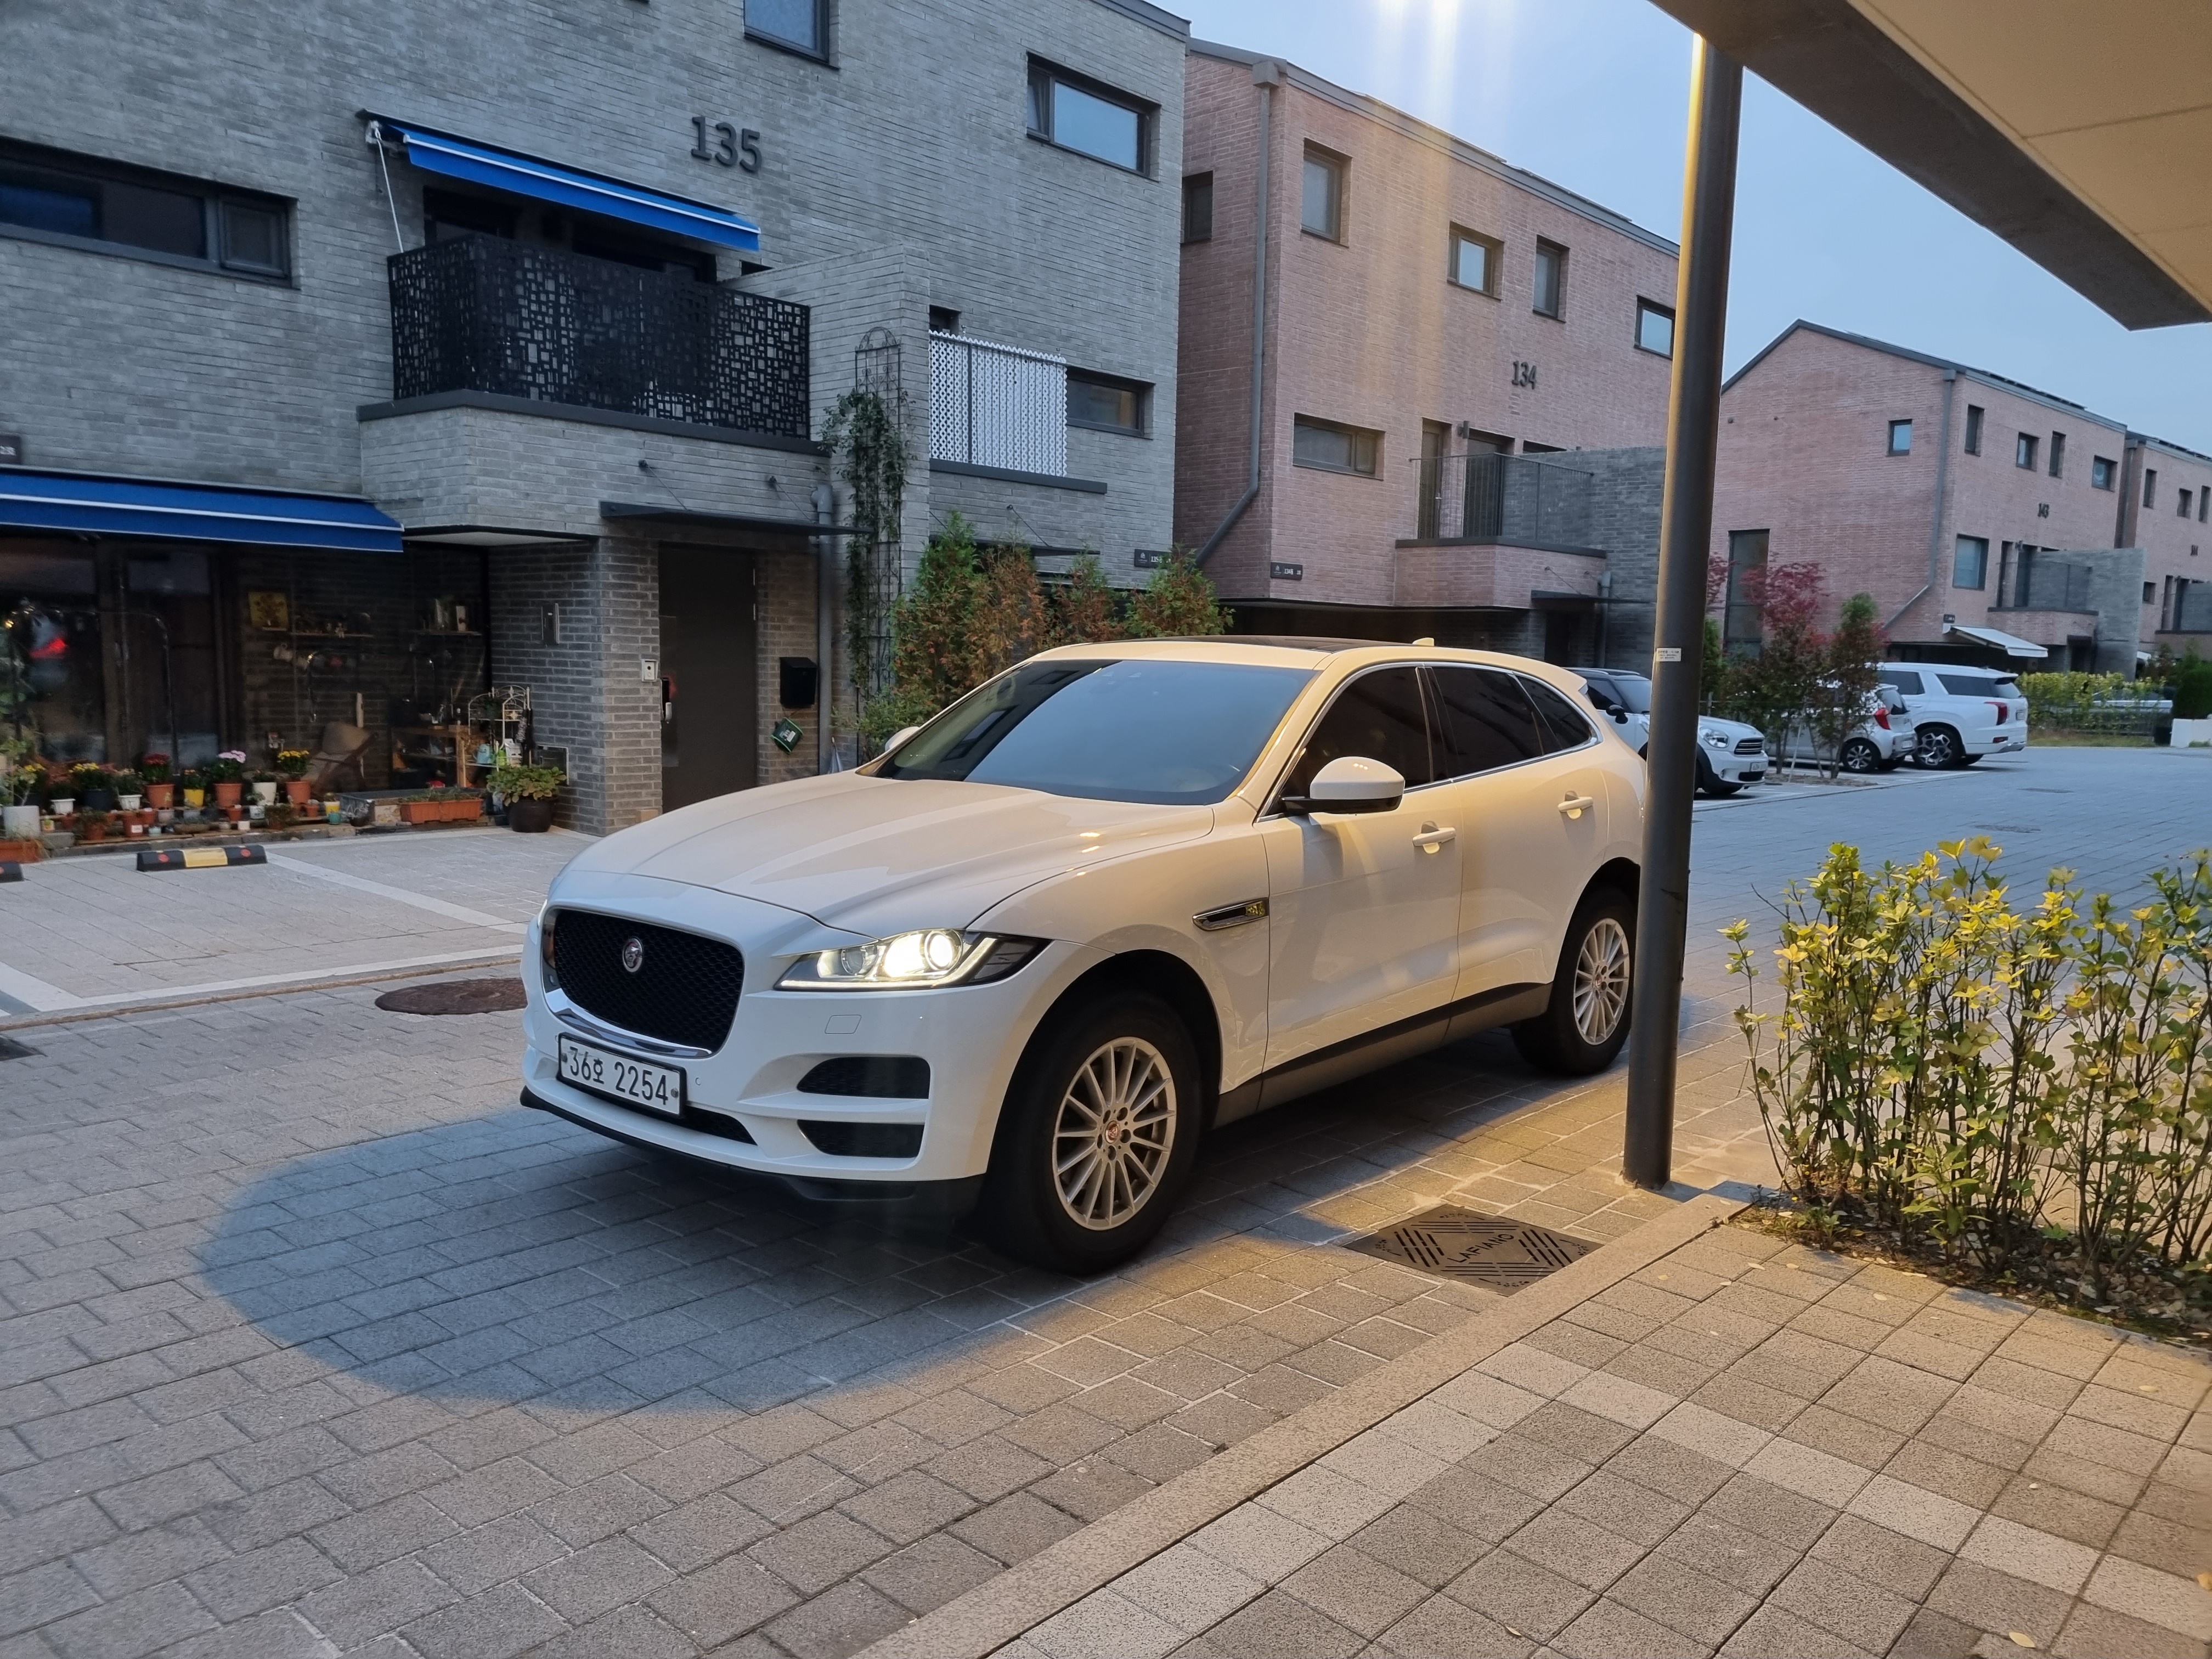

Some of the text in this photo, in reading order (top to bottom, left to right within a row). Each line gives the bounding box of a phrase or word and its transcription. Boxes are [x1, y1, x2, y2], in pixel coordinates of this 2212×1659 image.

[691, 116, 763, 173] 135
[1512, 361, 1537, 390] 134
[569, 1046, 669, 1105] 36호 2254
[1447, 1234, 1514, 1262] LAFIANO
